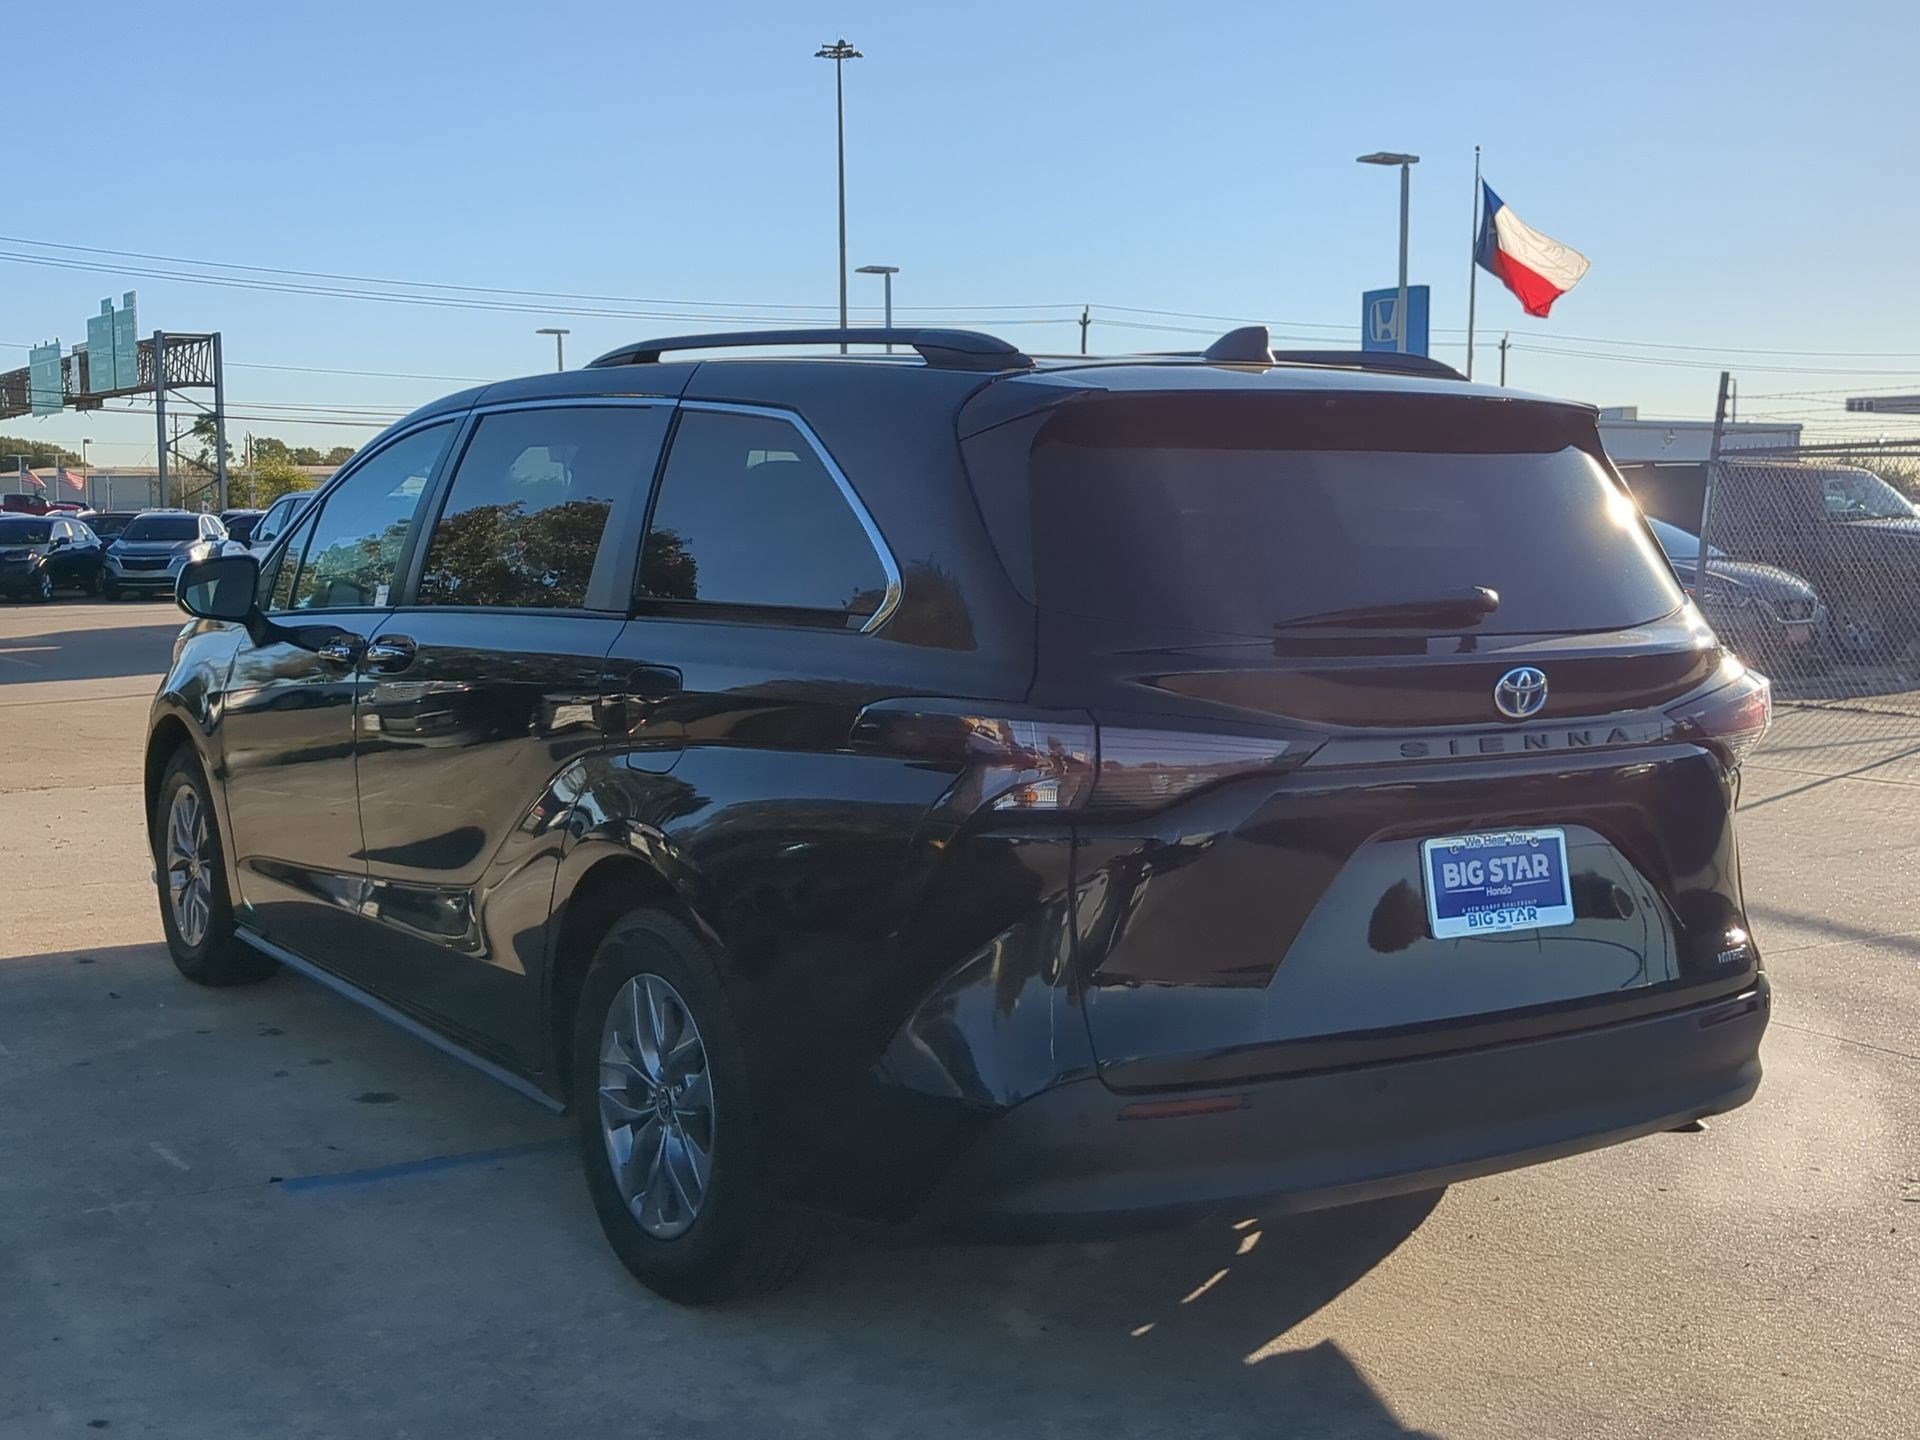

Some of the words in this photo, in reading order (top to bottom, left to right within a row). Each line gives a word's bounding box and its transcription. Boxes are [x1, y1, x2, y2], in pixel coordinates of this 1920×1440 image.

[1400, 727, 1630, 758] SIENNA
[1464, 837, 1482, 849] We
[1483, 834, 1506, 847] Hear
[1508, 832, 1527, 845] You
[1442, 859, 1485, 889] BIG
[1488, 853, 1550, 883] STAR
[1486, 884, 1512, 897] Honda
[1467, 911, 1493, 927] BIG
[1496, 907, 1538, 924] STAR
